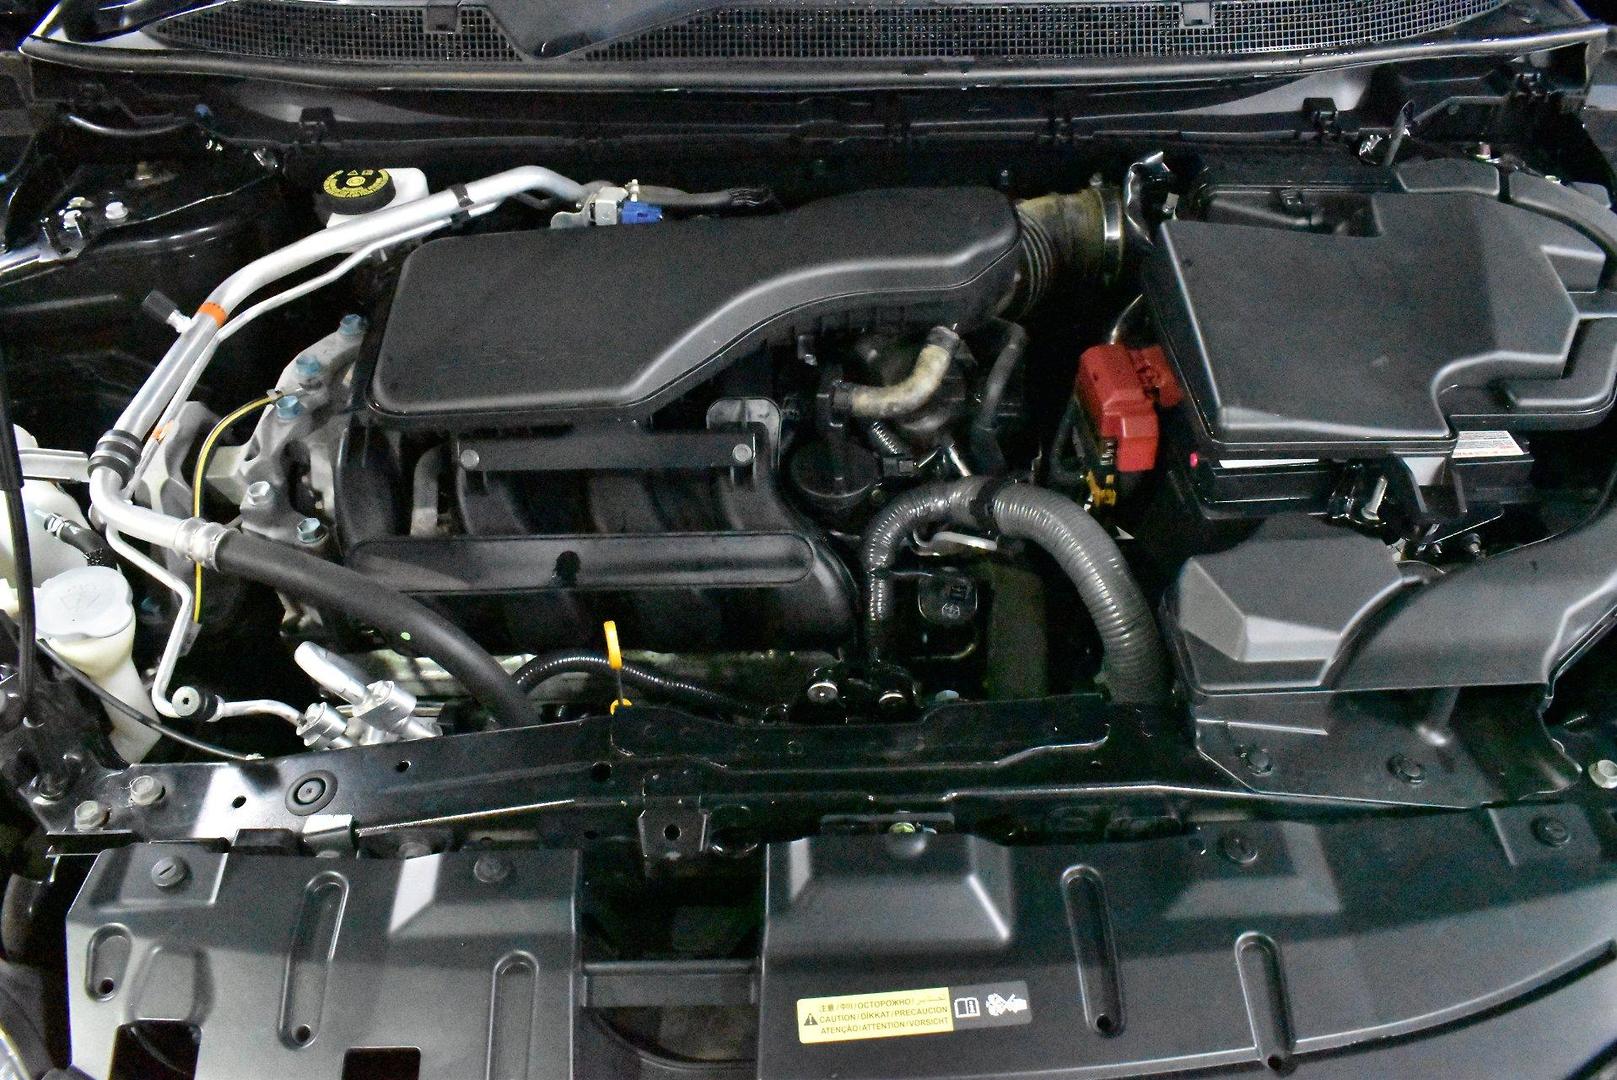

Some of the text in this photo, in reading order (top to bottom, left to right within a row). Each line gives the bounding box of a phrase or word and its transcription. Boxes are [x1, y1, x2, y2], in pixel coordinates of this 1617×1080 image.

[819, 1014, 856, 1023] CAUTION
[862, 1021, 905, 1031] ATTENTION
[910, 1017, 948, 1027] VORSICHT
